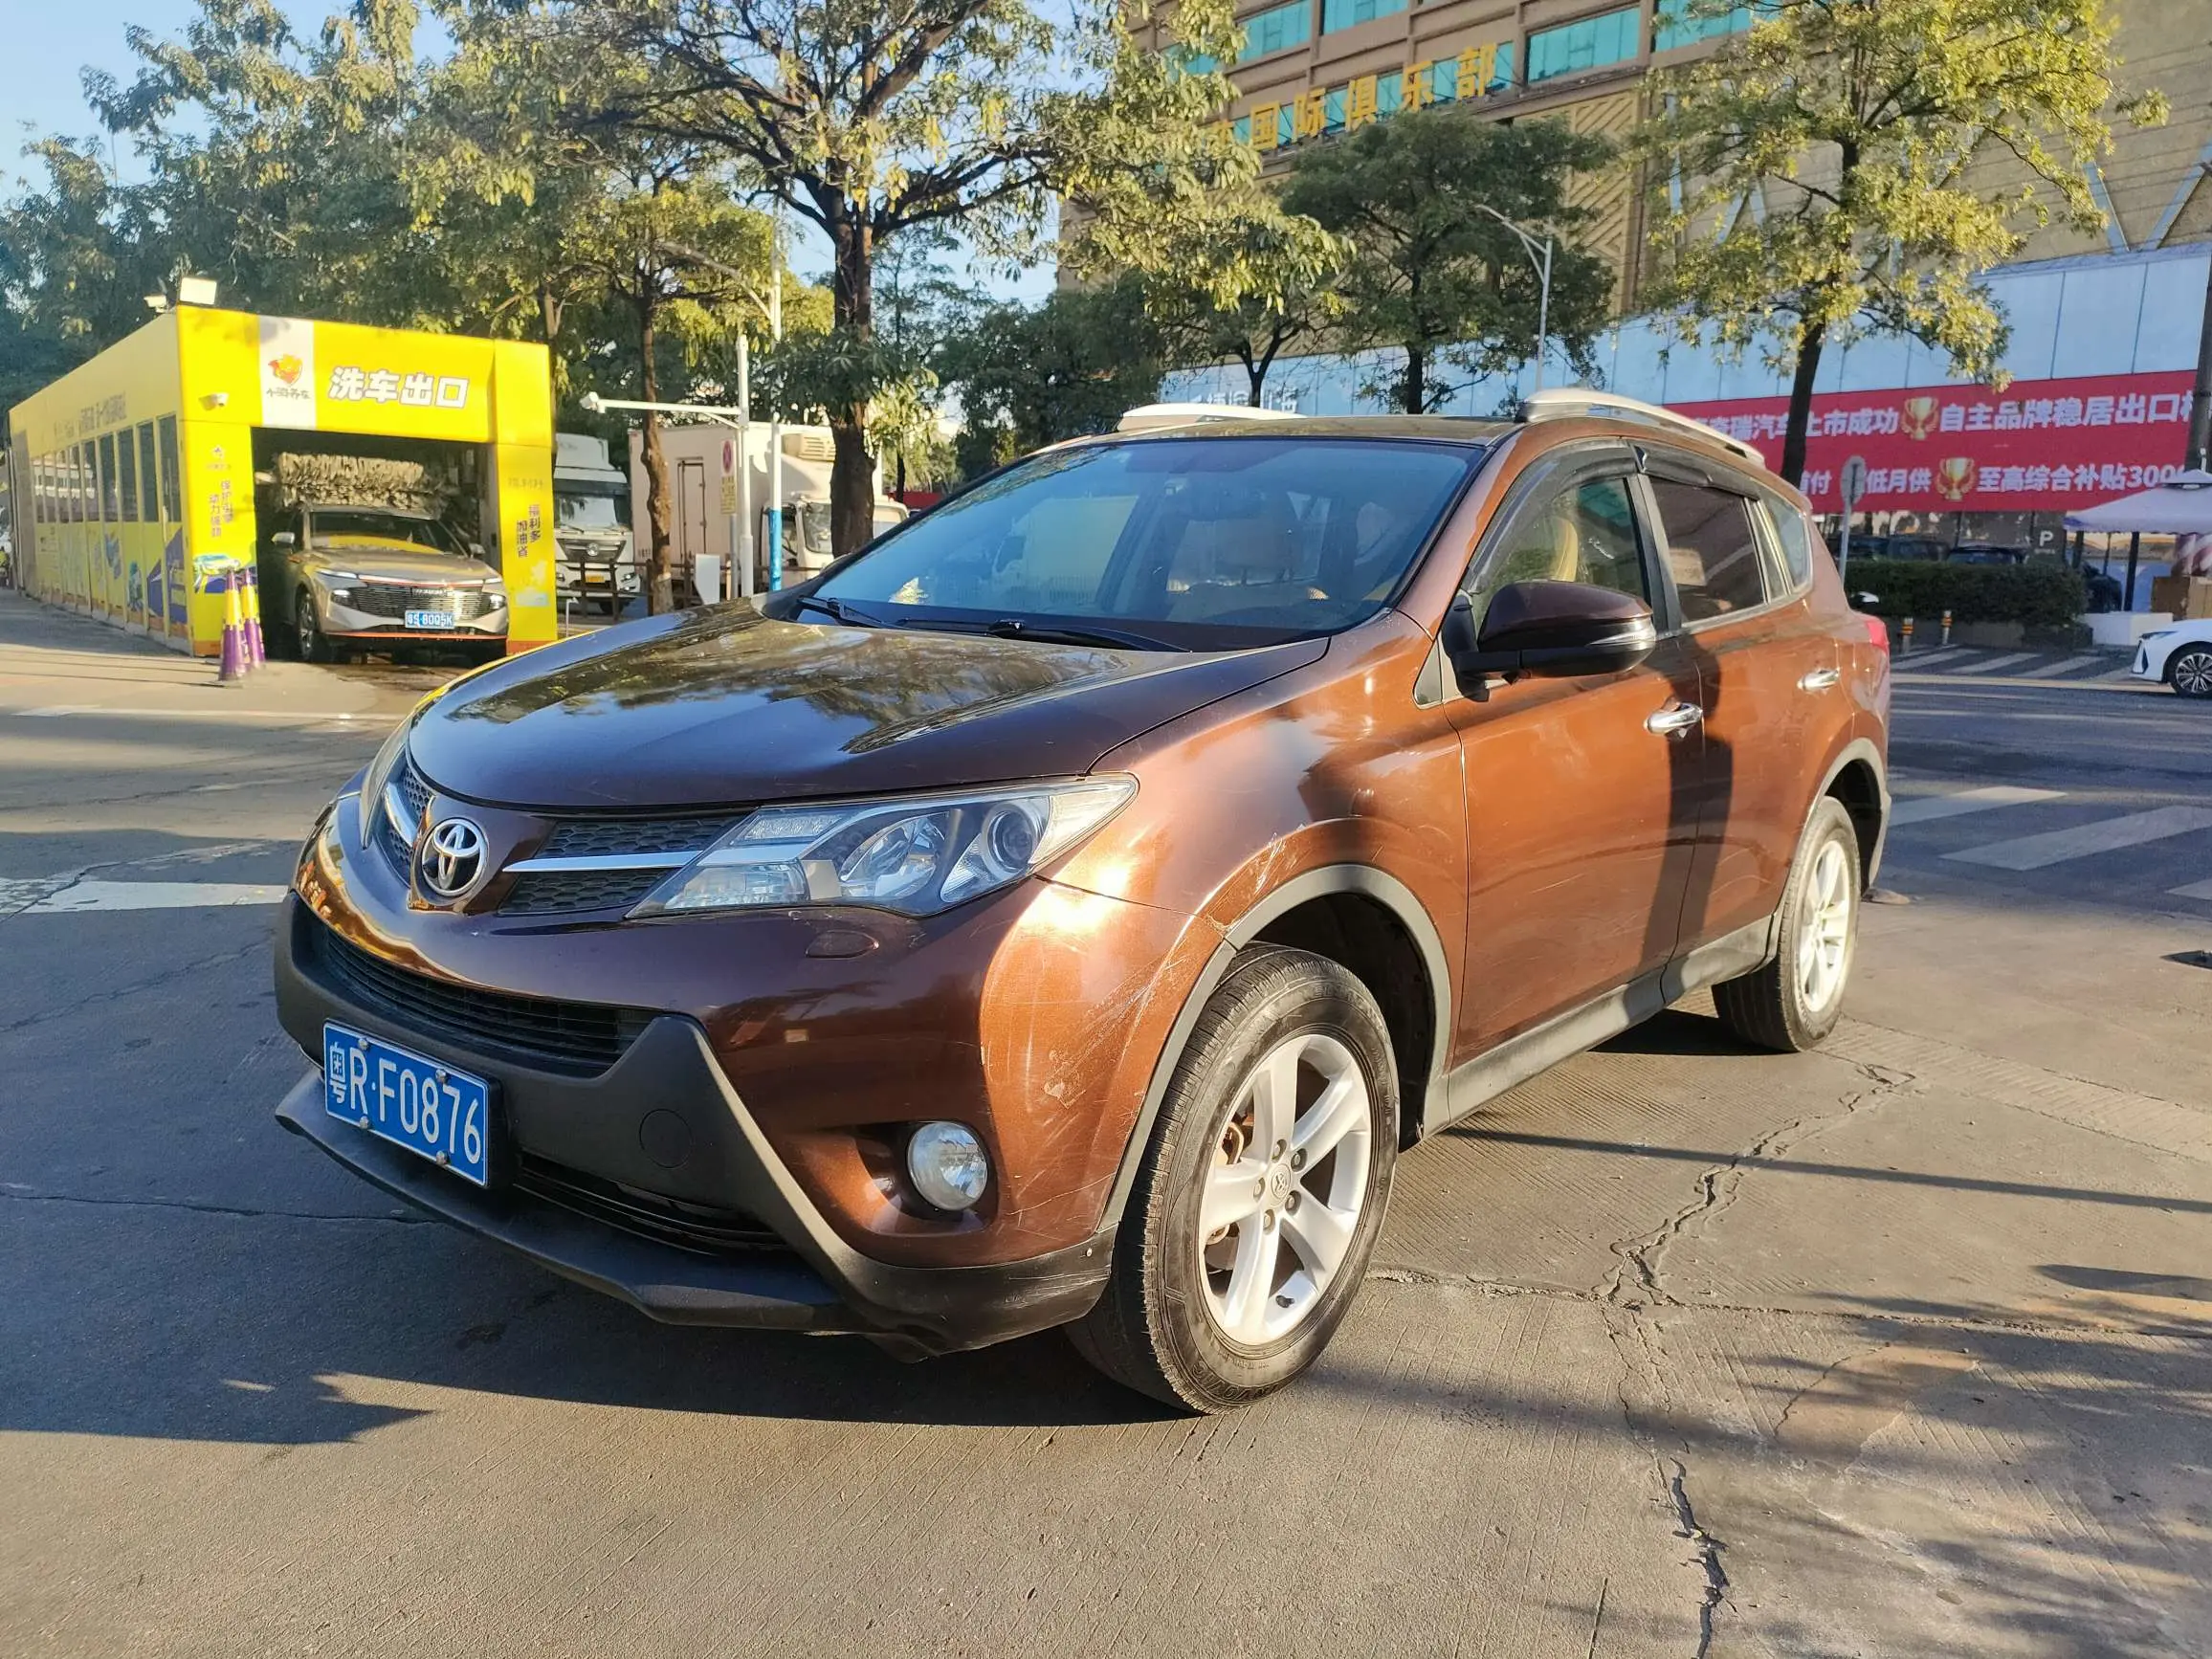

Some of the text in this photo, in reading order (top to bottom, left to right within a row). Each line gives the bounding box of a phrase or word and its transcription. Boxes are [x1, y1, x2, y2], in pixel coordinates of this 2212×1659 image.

[1213, 42, 1496, 151] 国际俱乐部
[328, 365, 470, 409] 洗车出口
[1862, 468, 1931, 495] 低月供
[2039, 530, 2054, 547] P
